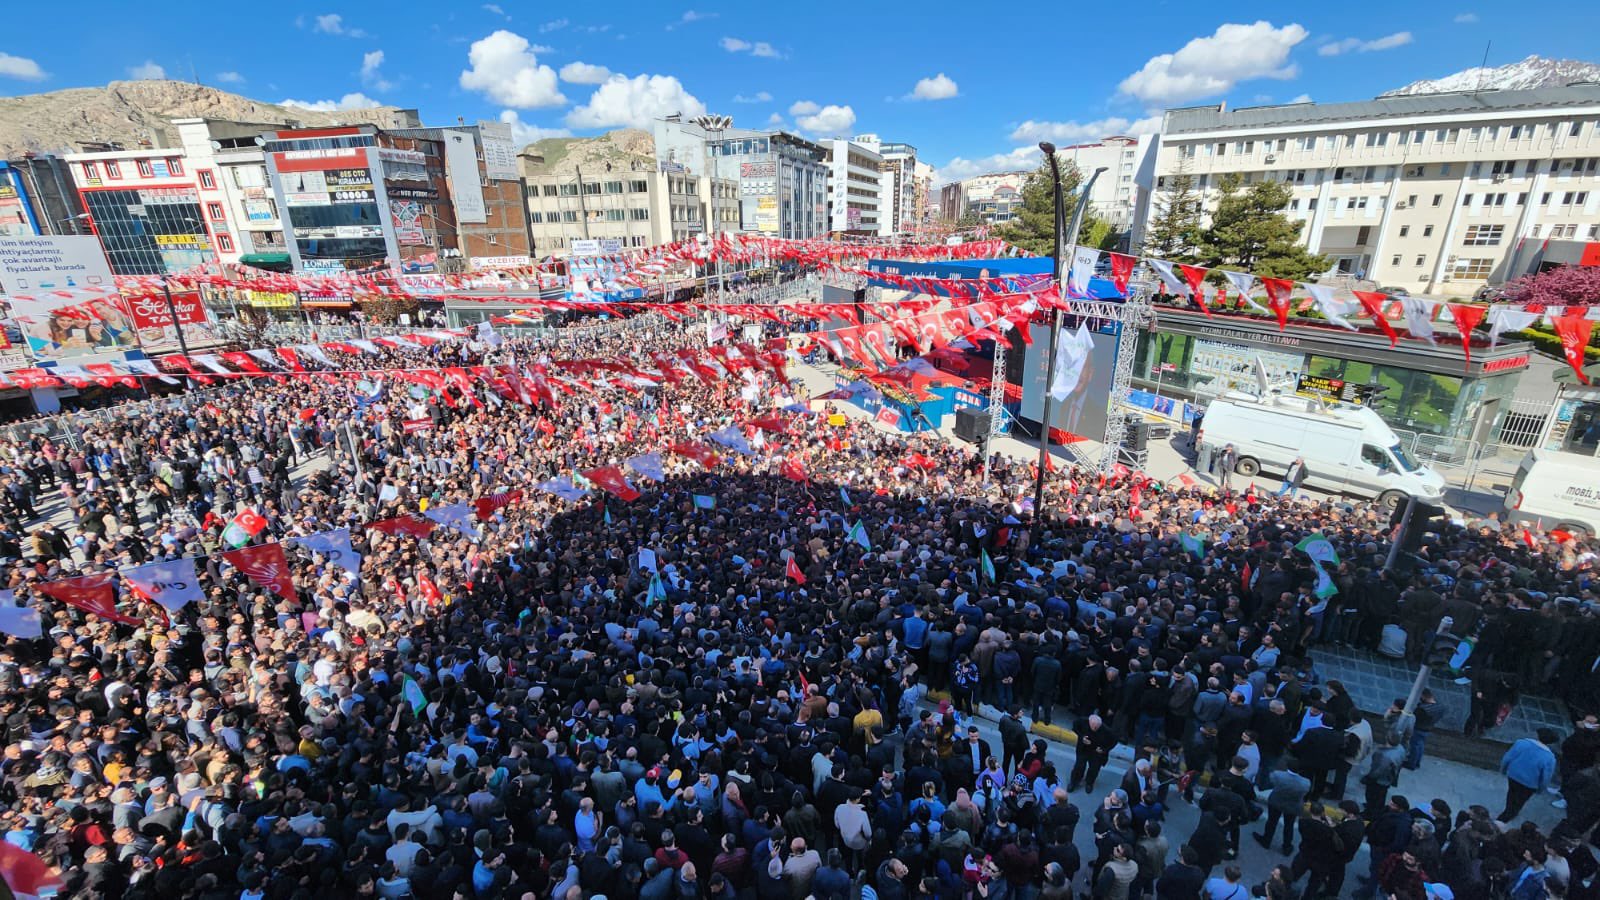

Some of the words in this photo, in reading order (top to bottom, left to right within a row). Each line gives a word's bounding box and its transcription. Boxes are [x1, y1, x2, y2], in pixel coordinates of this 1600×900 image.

[3, 257, 20, 265] çok
[22, 256, 62, 264] avantajlı
[6, 266, 51, 274] fiyatlarla
[1246, 332, 1261, 340] YER
[1280, 337, 1301, 346] AVM
[955, 391, 981, 407] SANA
